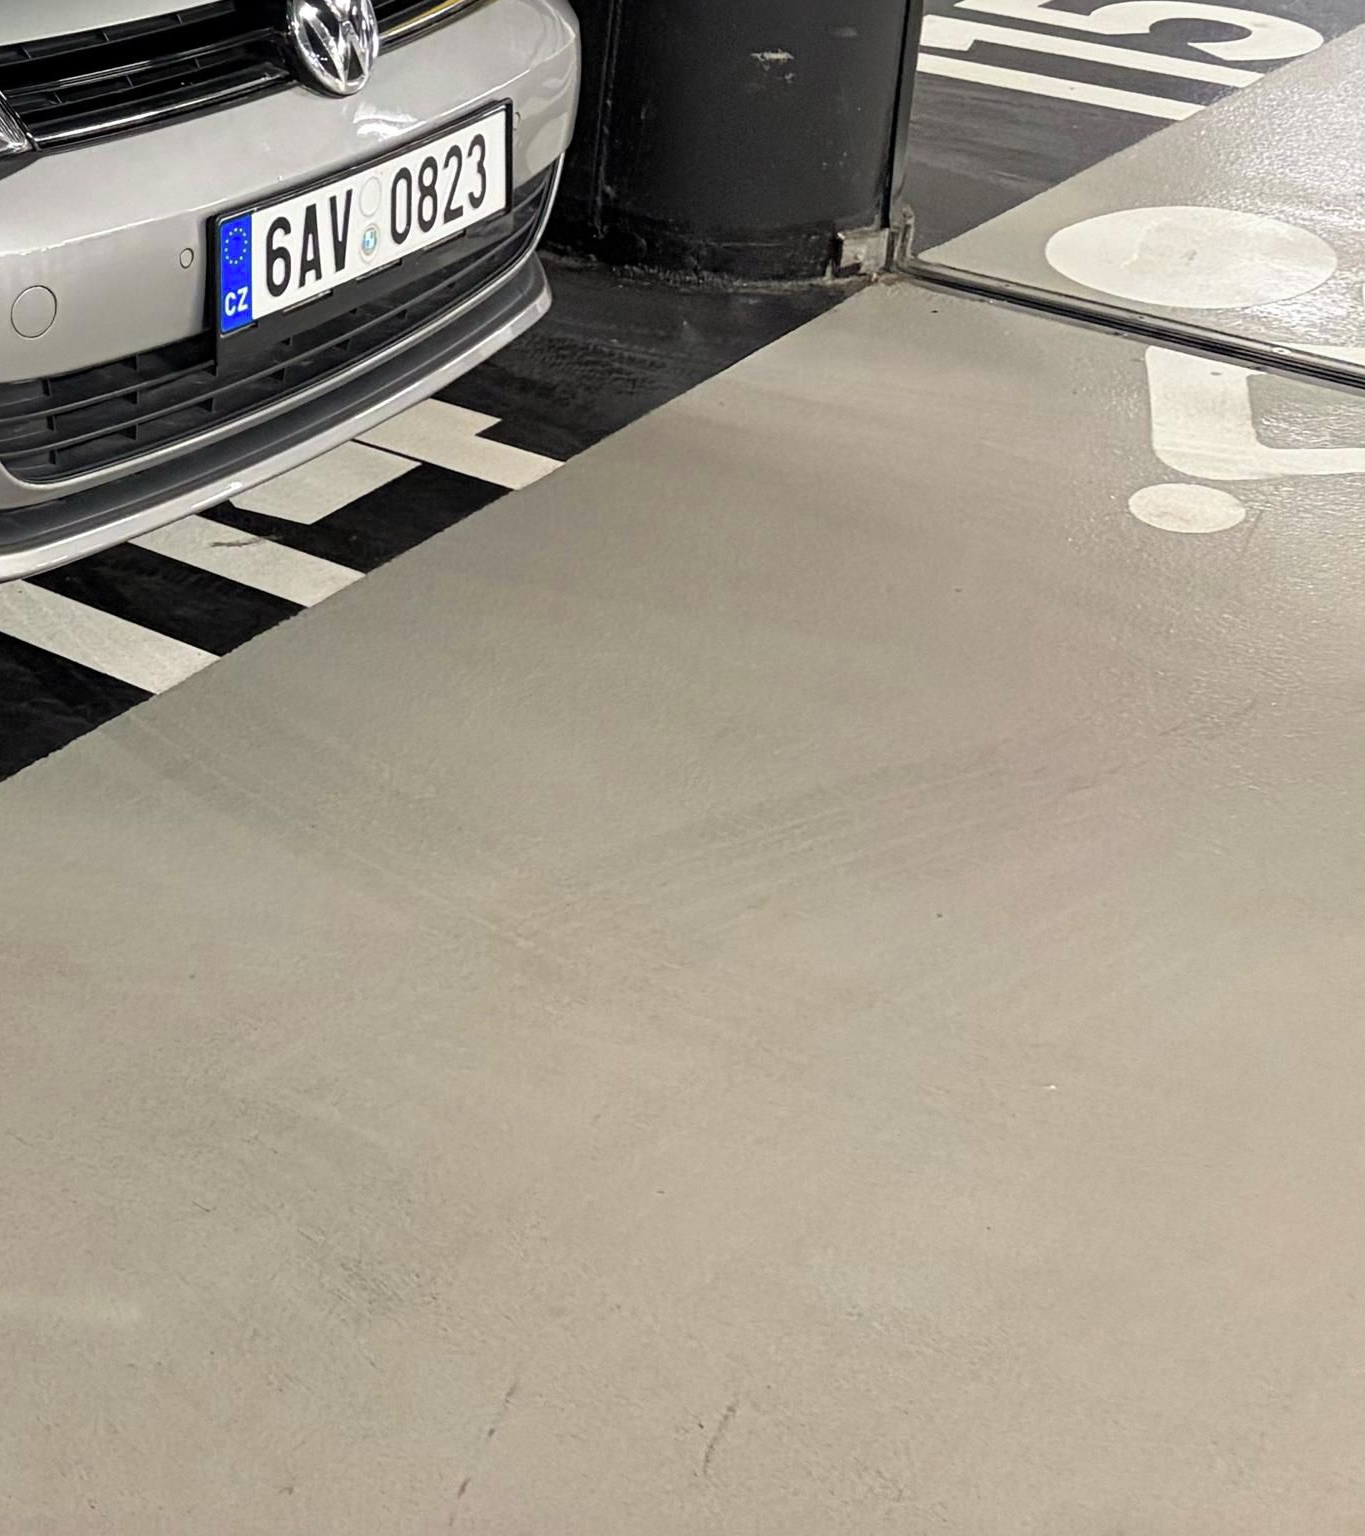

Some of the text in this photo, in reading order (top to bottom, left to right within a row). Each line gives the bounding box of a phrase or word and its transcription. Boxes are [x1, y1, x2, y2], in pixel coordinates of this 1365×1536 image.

[265, 133, 487, 297] 6AV 0823
[224, 286, 249, 316] CZ
